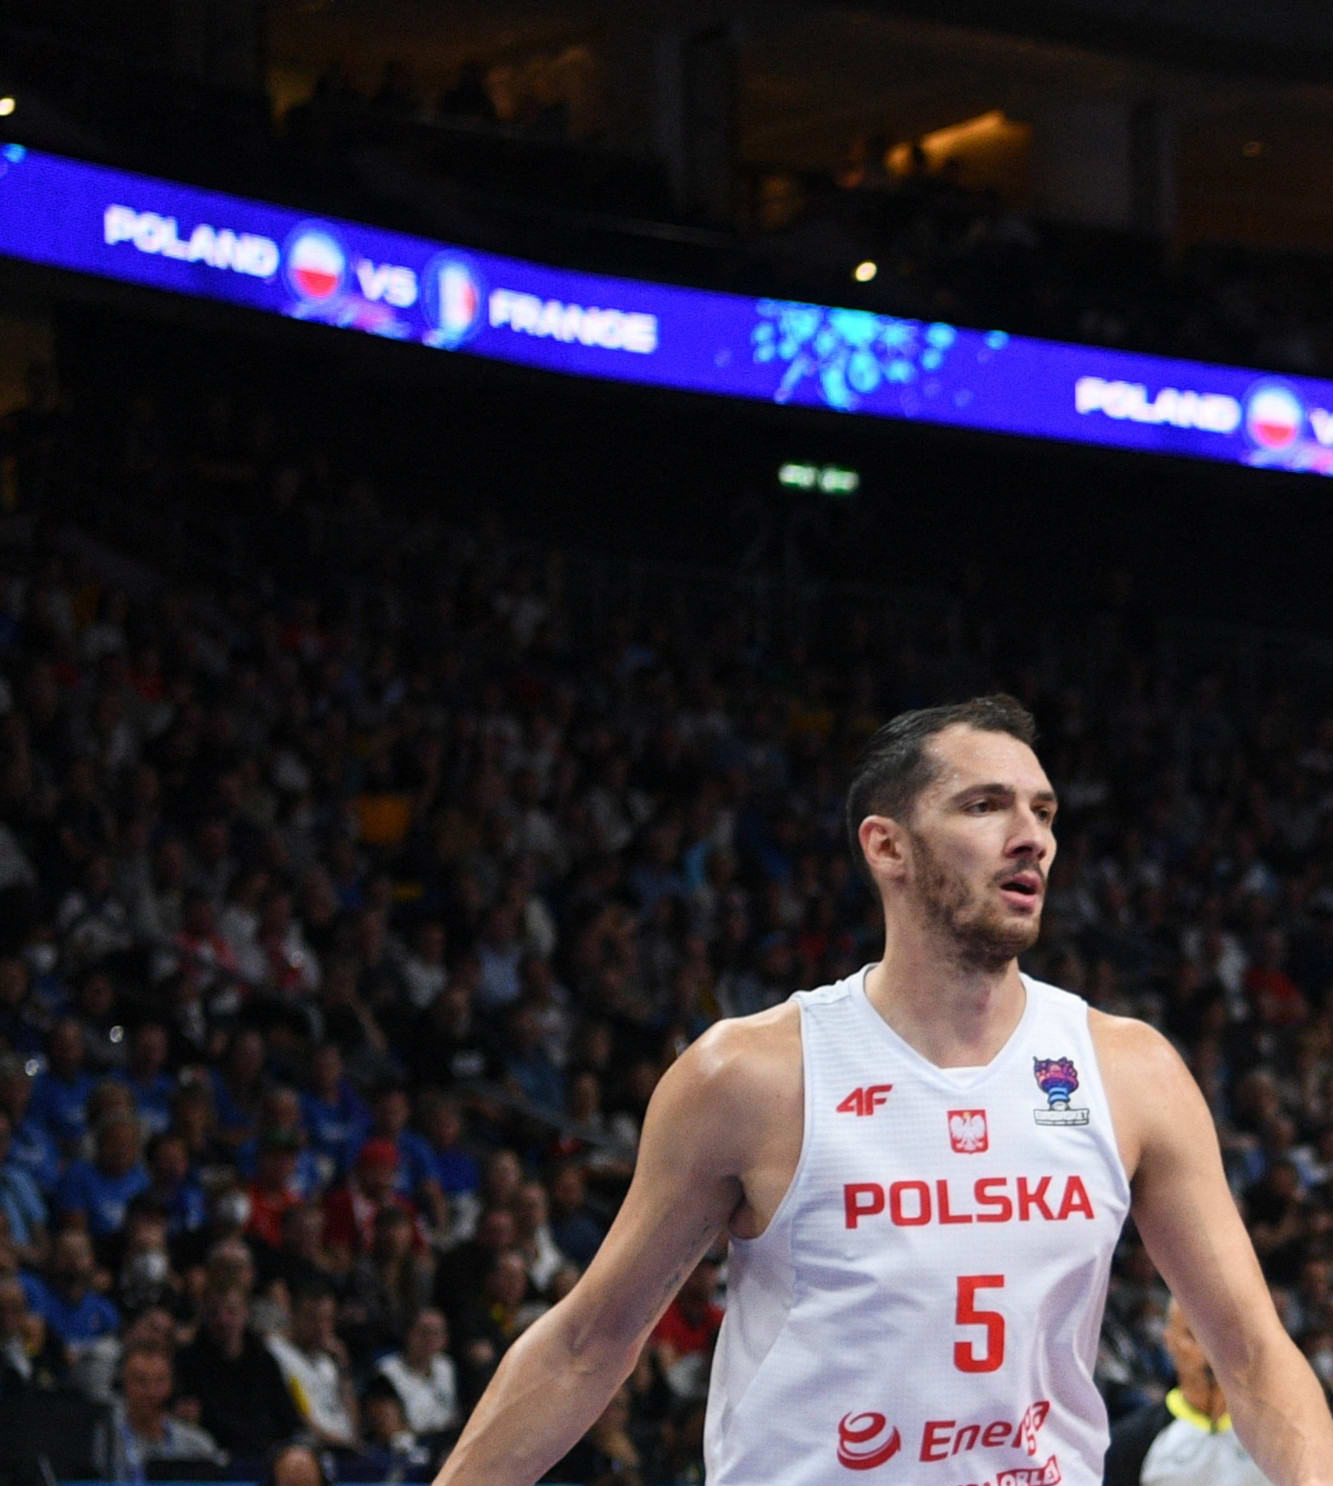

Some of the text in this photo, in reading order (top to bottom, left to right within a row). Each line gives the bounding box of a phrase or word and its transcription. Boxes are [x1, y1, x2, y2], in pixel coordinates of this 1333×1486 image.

[103, 203, 660, 355] POLAND VS FRANCE
[1074, 376, 1241, 434] POLAND
[836, 1084, 893, 1117] 4F
[843, 1176, 1095, 1229] POLSKA
[953, 1274, 1005, 1373] 5
